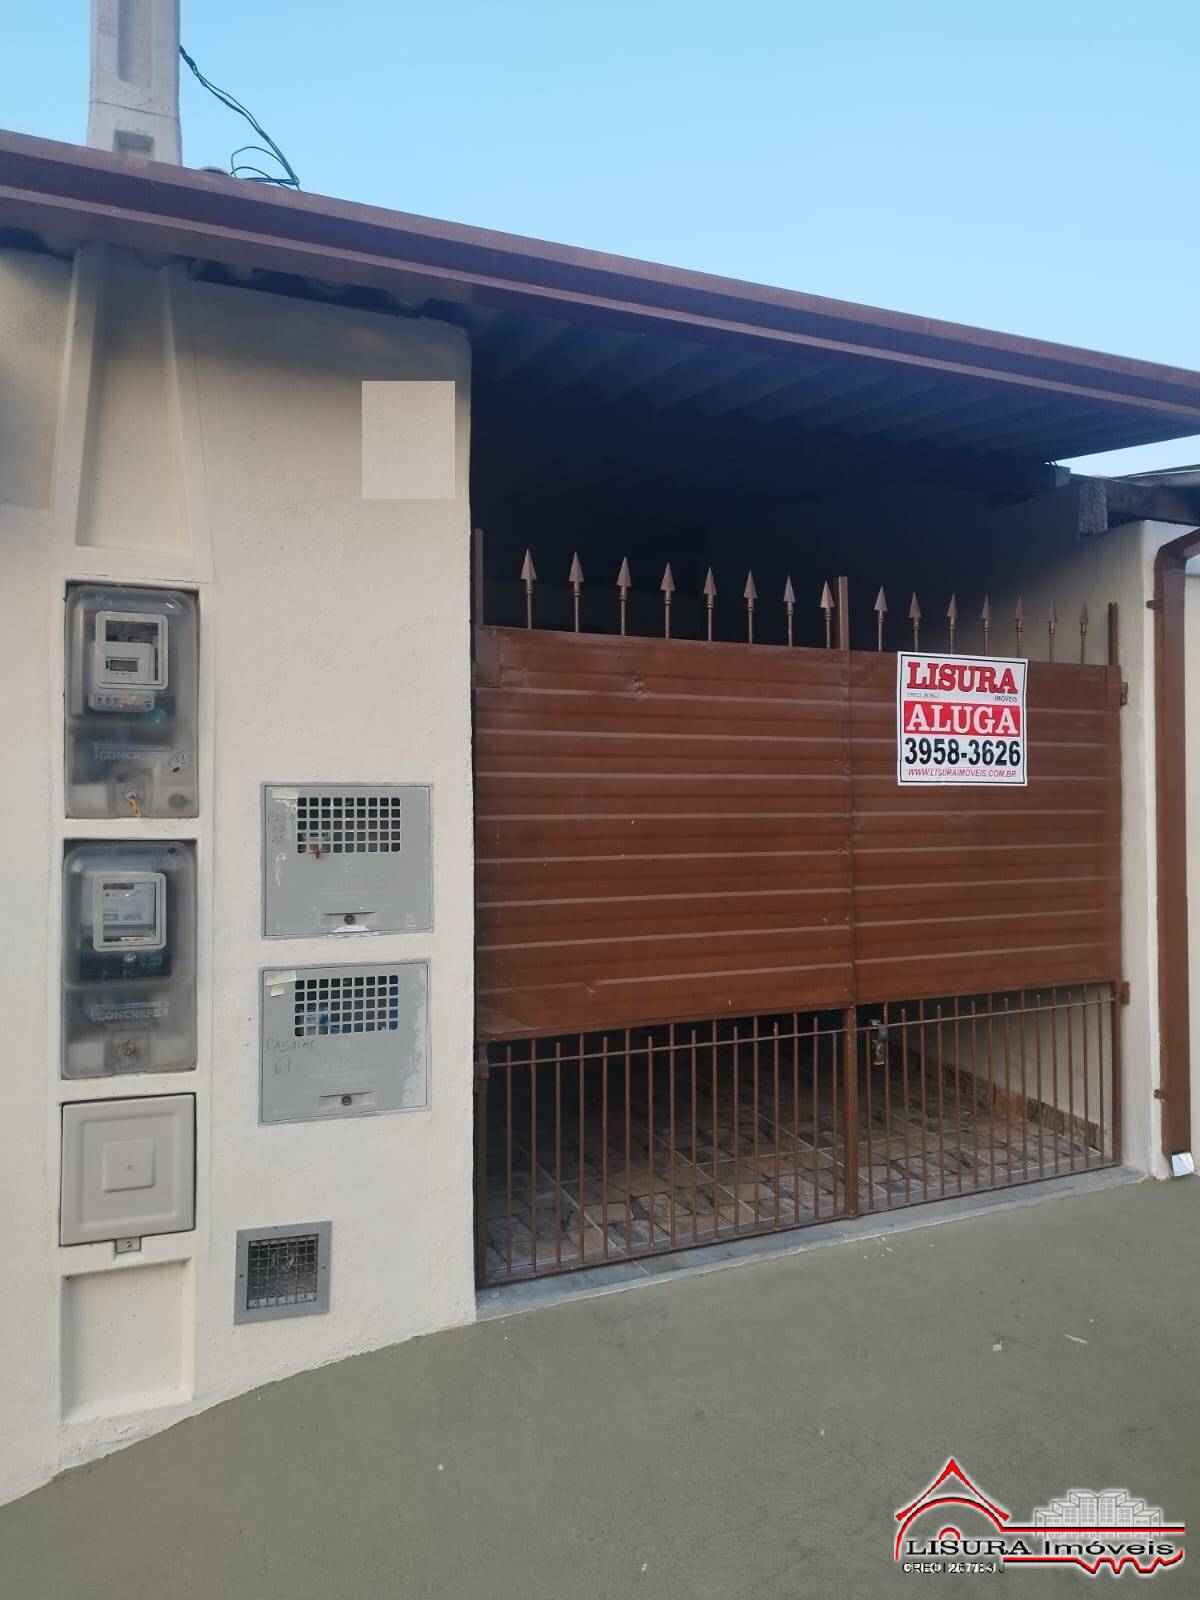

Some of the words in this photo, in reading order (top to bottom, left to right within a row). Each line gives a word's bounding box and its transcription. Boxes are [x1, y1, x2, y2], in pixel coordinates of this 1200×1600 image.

[907, 662, 1018, 694] LISURA
[906, 703, 1018, 735] ALUGA
[904, 737, 1021, 767] 3958-3626
[908, 768, 1017, 778] WWW.LISURAIMOVEIS.COM.BR
